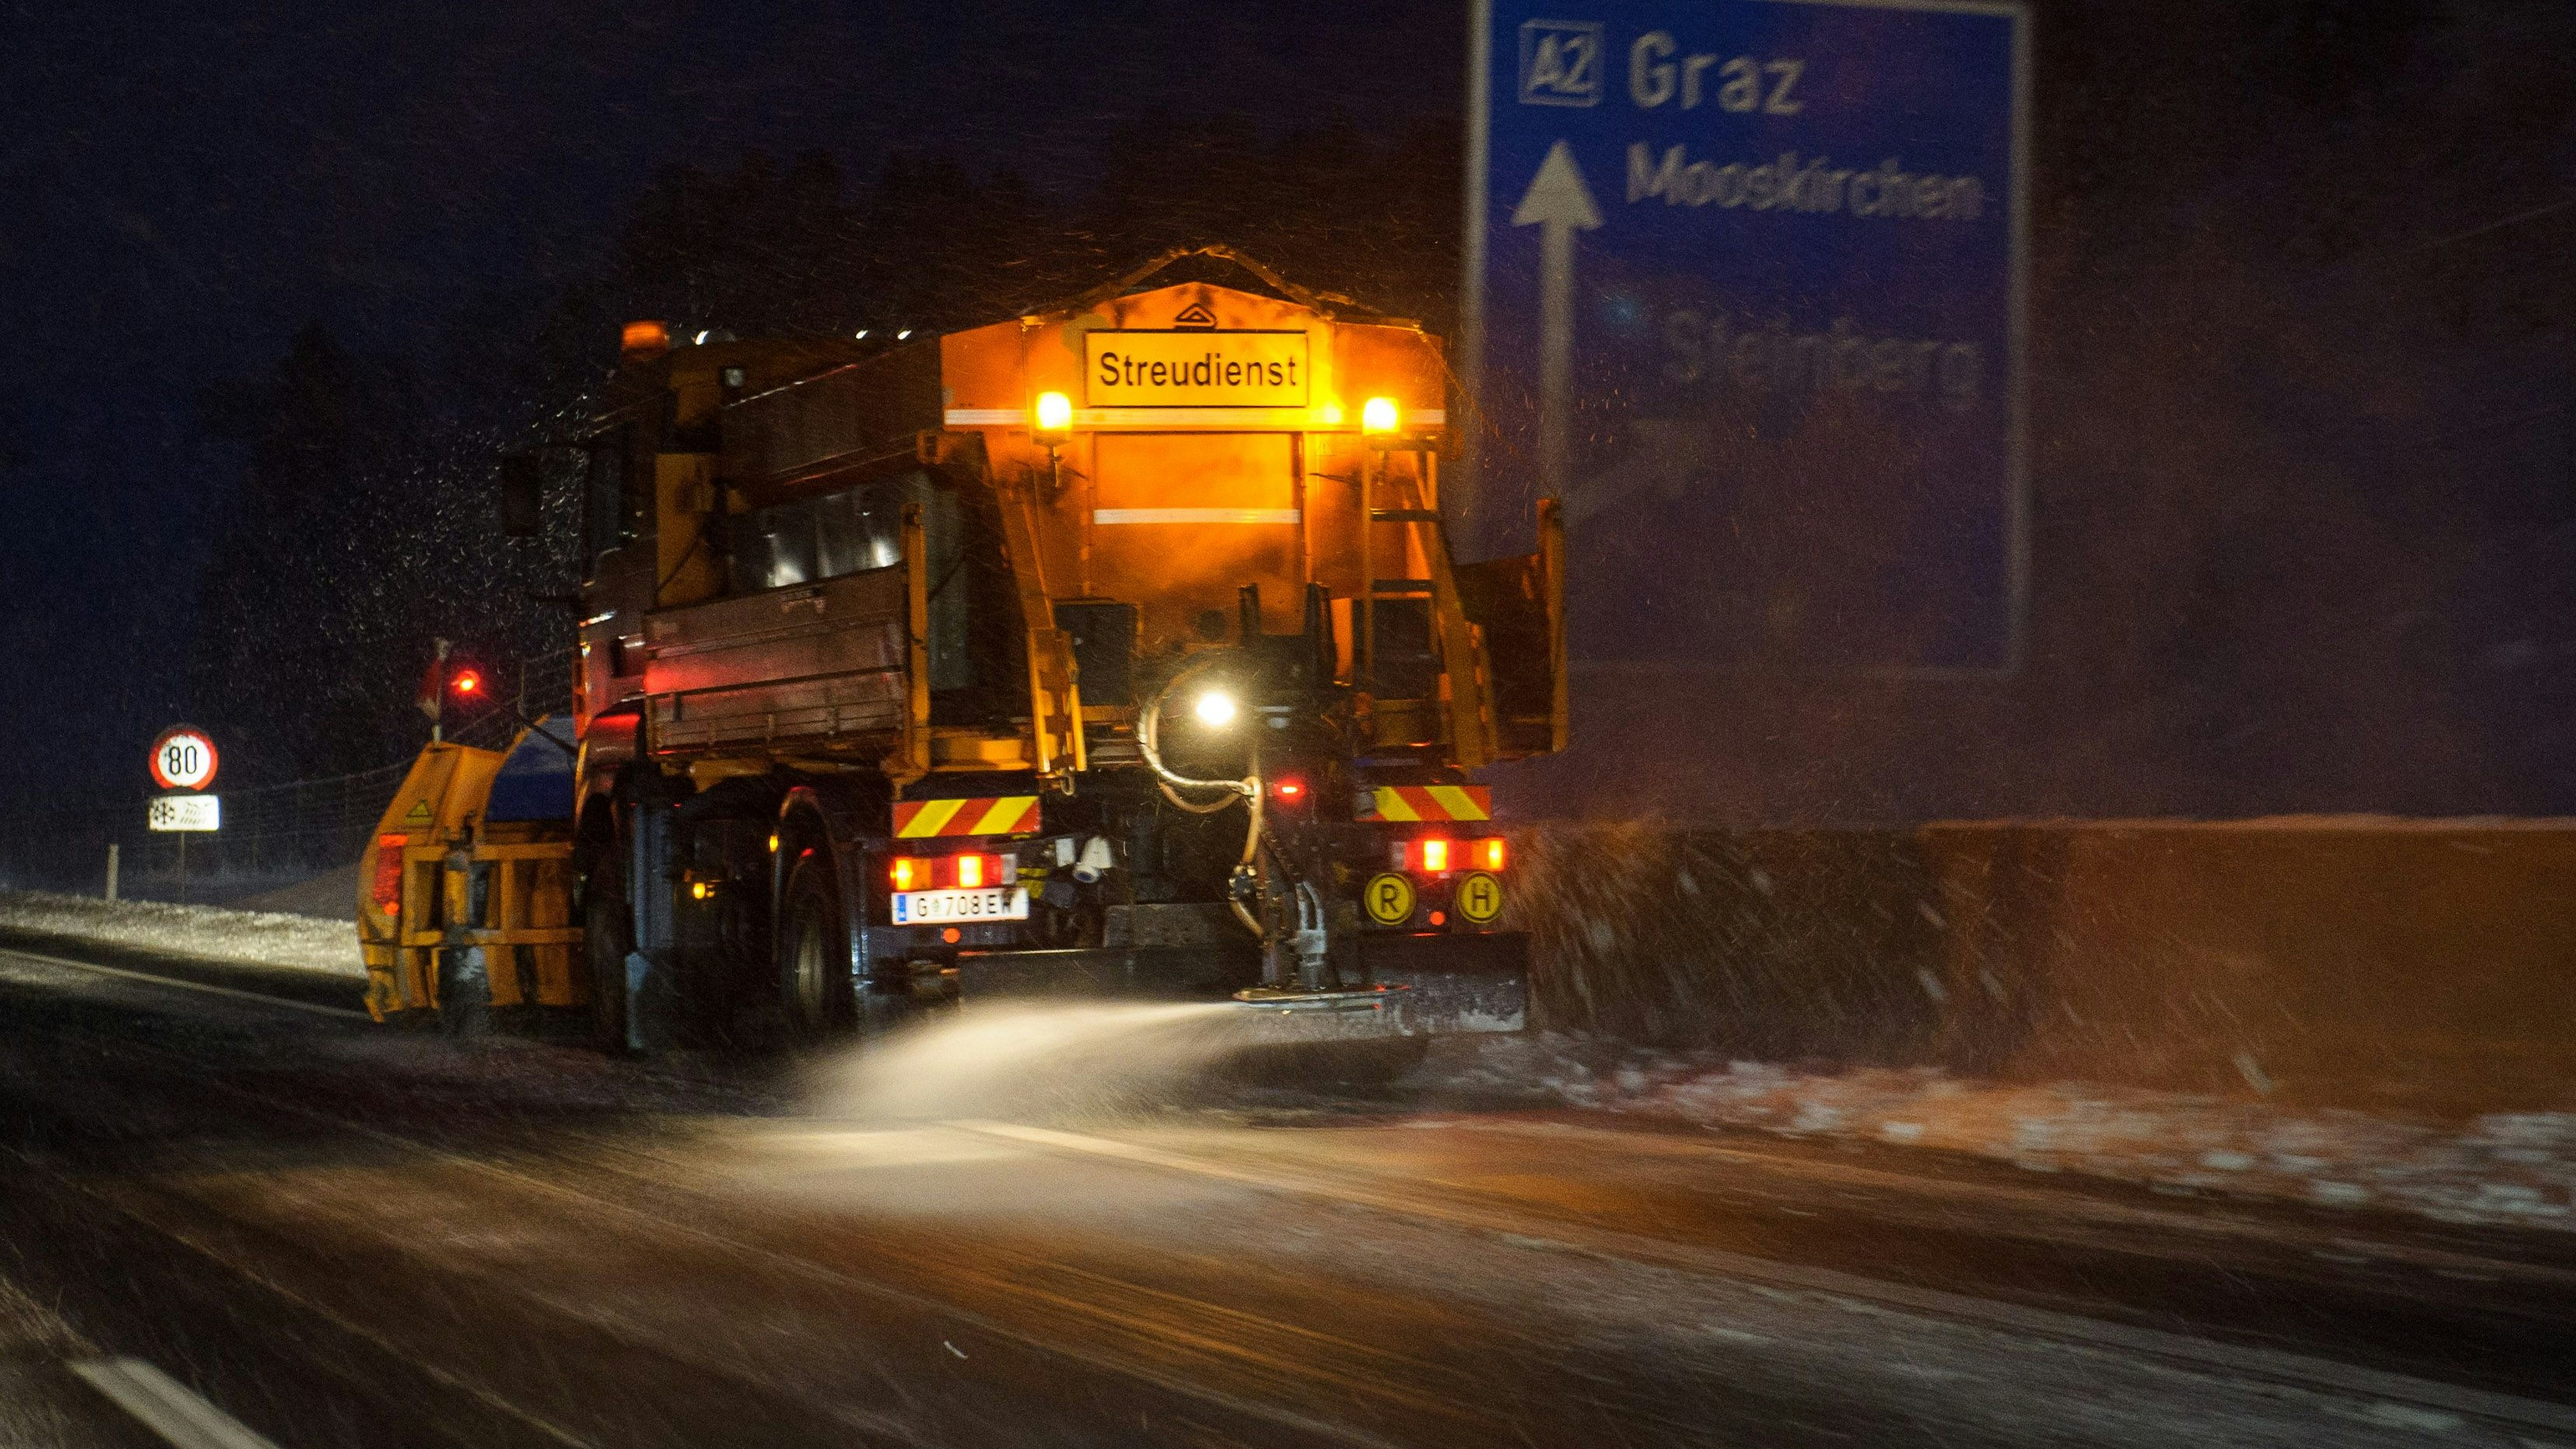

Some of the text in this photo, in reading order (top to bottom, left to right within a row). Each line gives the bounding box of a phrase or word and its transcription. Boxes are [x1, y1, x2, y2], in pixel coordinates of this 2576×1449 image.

[1527, 31, 1806, 114] A2 Graz
[1627, 142, 1984, 220] Mooskirchen
[1100, 352, 1297, 387] Streudienst
[170, 745, 197, 775] 80
[1380, 884, 1398, 913] R
[1472, 882, 1489, 912] H
